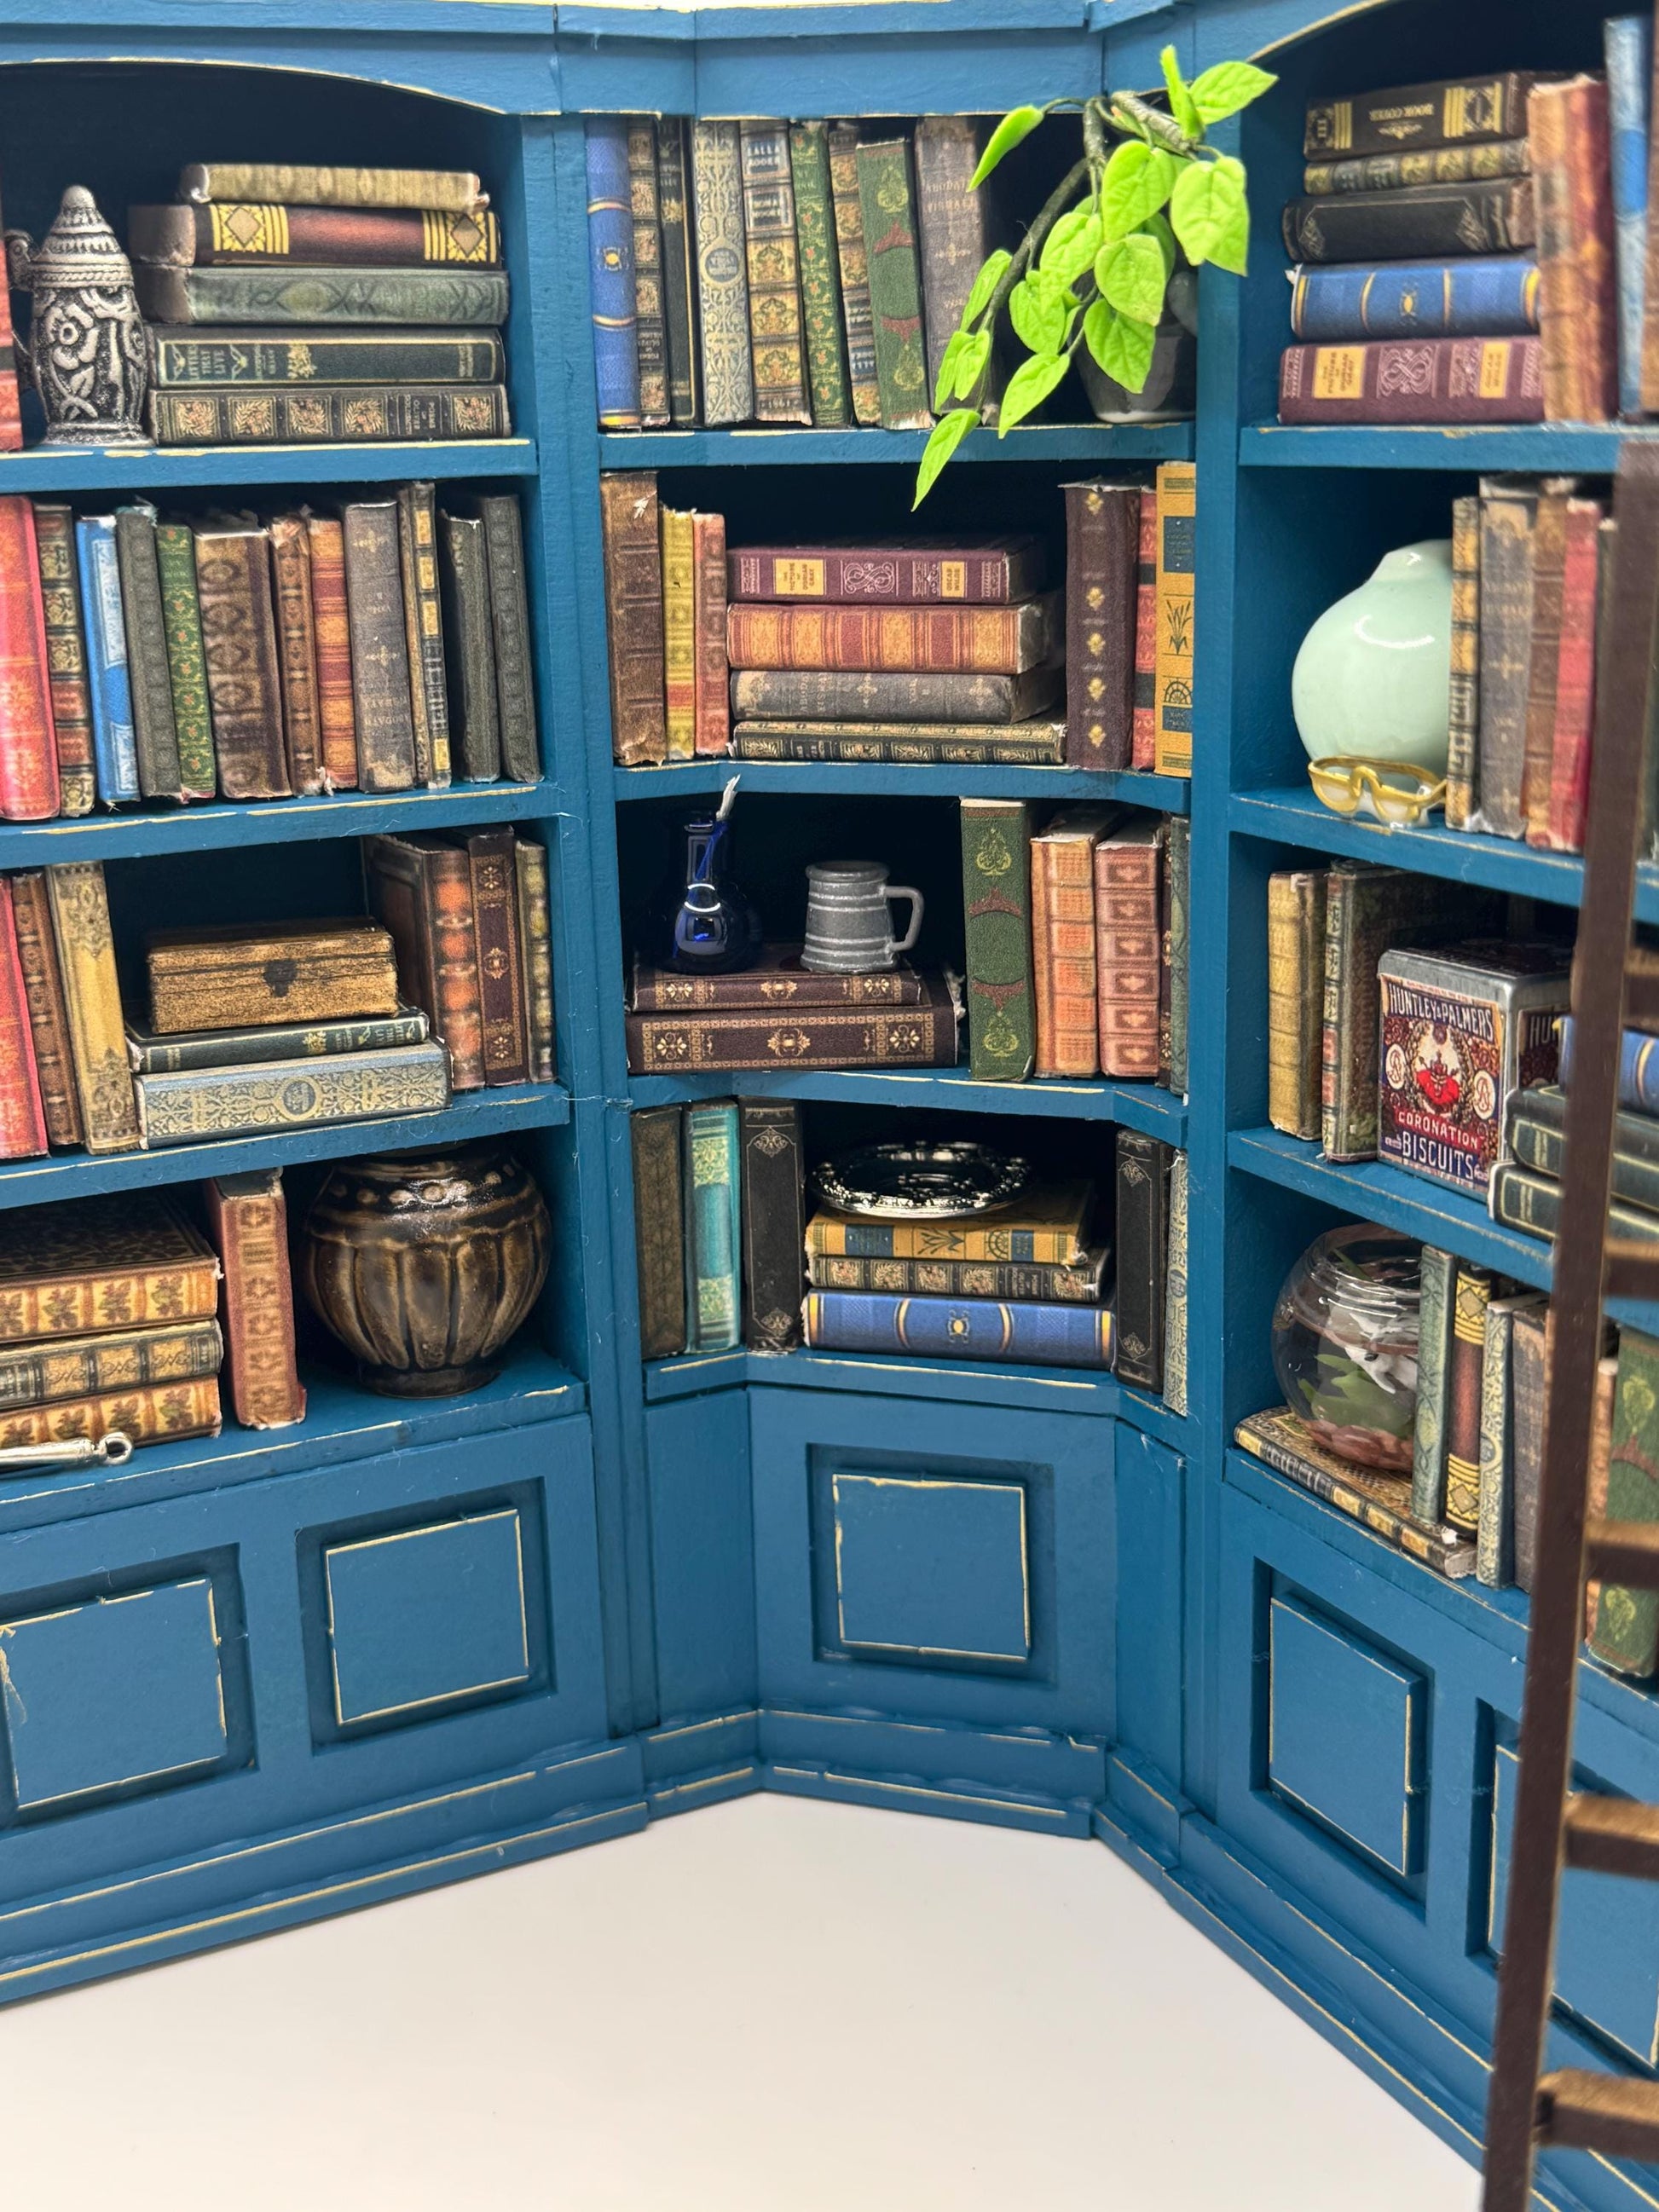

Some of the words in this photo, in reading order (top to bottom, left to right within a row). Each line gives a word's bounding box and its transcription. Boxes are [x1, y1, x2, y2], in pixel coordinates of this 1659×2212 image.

[1388, 982, 1437, 1020] HUNTLEY
[1441, 1002, 1494, 1042] PALMERS
[1398, 1111, 1478, 1150] CORONATION
[1402, 1131, 1474, 1180] BISCUITS
